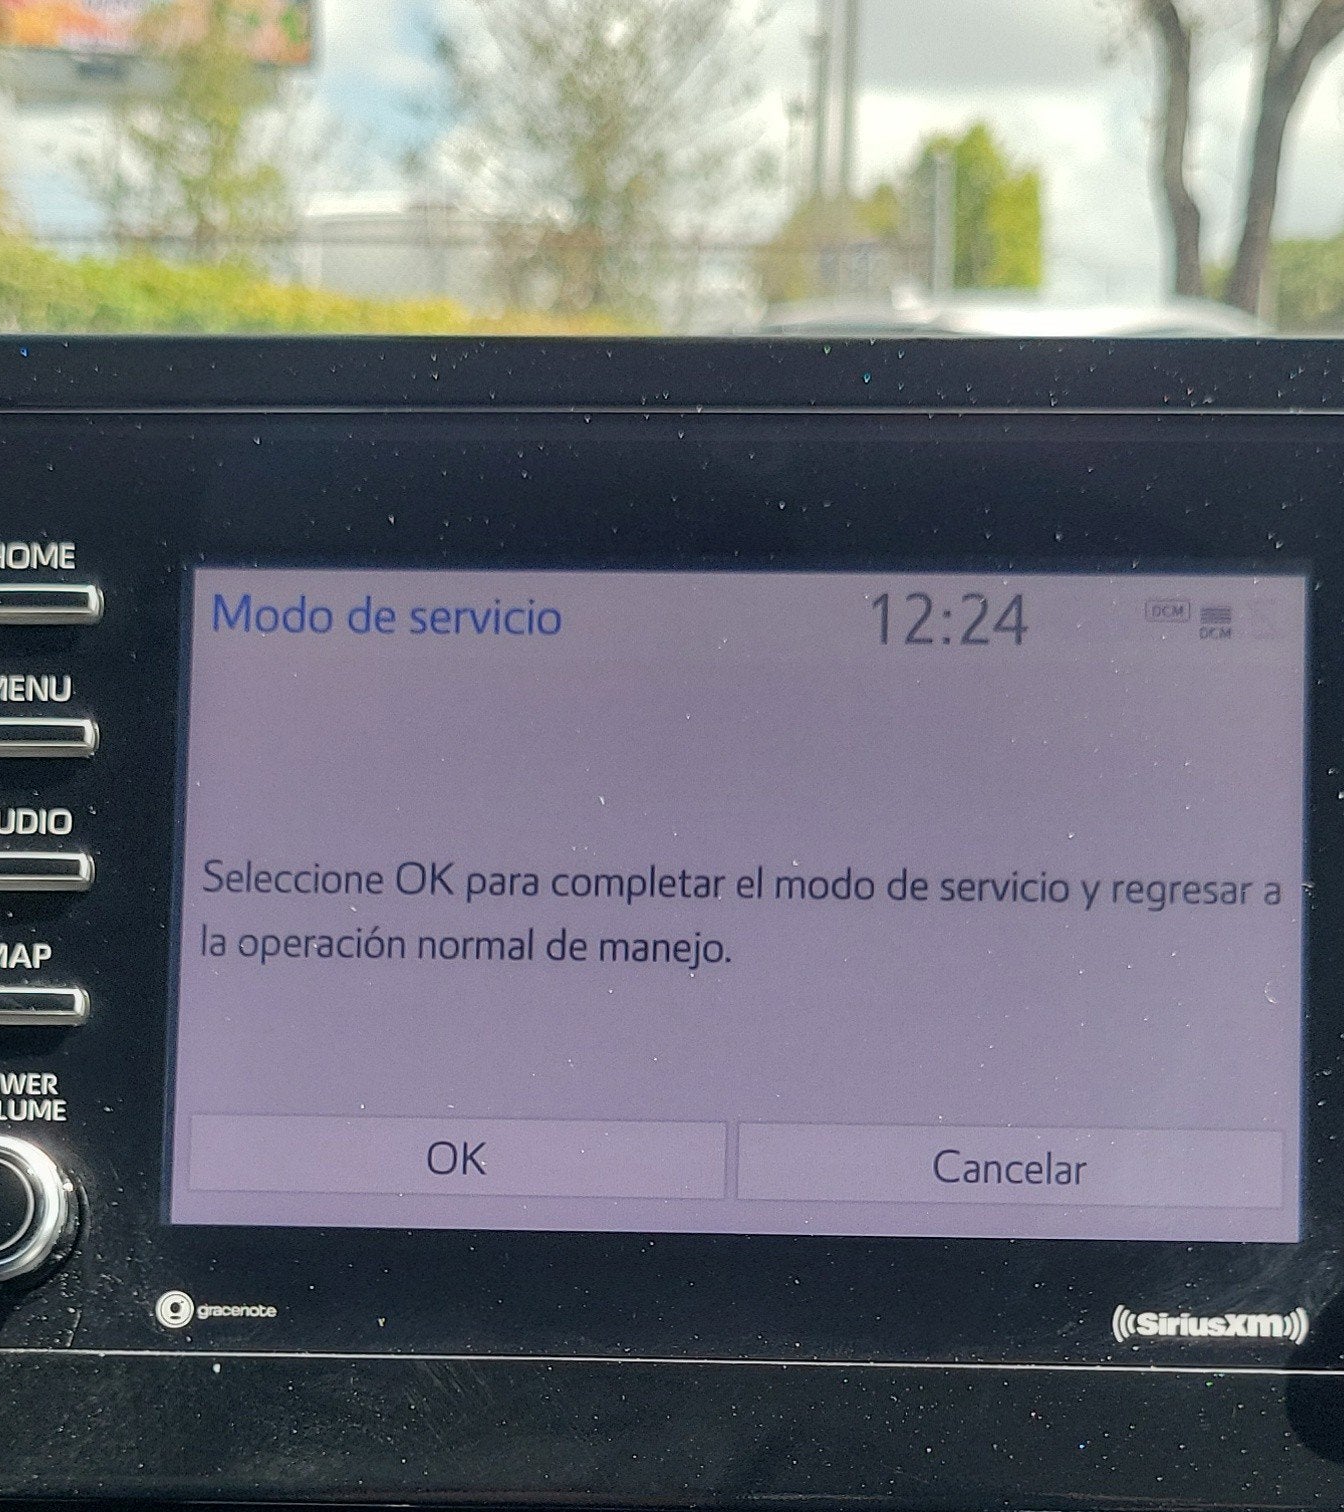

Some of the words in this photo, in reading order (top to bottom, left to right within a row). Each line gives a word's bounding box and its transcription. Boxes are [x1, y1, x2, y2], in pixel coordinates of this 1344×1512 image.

[213, 594, 333, 633] Modo
[348, 595, 396, 634] de
[410, 599, 561, 635] servicio
[872, 592, 1028, 645] 12:24
[203, 859, 383, 895] Seleccione
[396, 861, 453, 895] OK
[466, 873, 539, 903] para
[552, 864, 725, 904] completar
[737, 866, 763, 899] el
[776, 867, 875, 900] modo
[887, 868, 928, 901] de
[940, 871, 1070, 903] servicio
[1081, 880, 1101, 911] y
[1112, 880, 1253, 912] regresar
[1264, 882, 1281, 905] a
[201, 923, 226, 957] la
[238, 926, 405, 965] operación
[418, 927, 534, 961] normal
[546, 928, 587, 961] de
[600, 932, 731, 966] manejo.
[427, 1141, 485, 1175] OK
[934, 1149, 1087, 1185] Cancelar
[197, 1305, 277, 1319] gracenote
